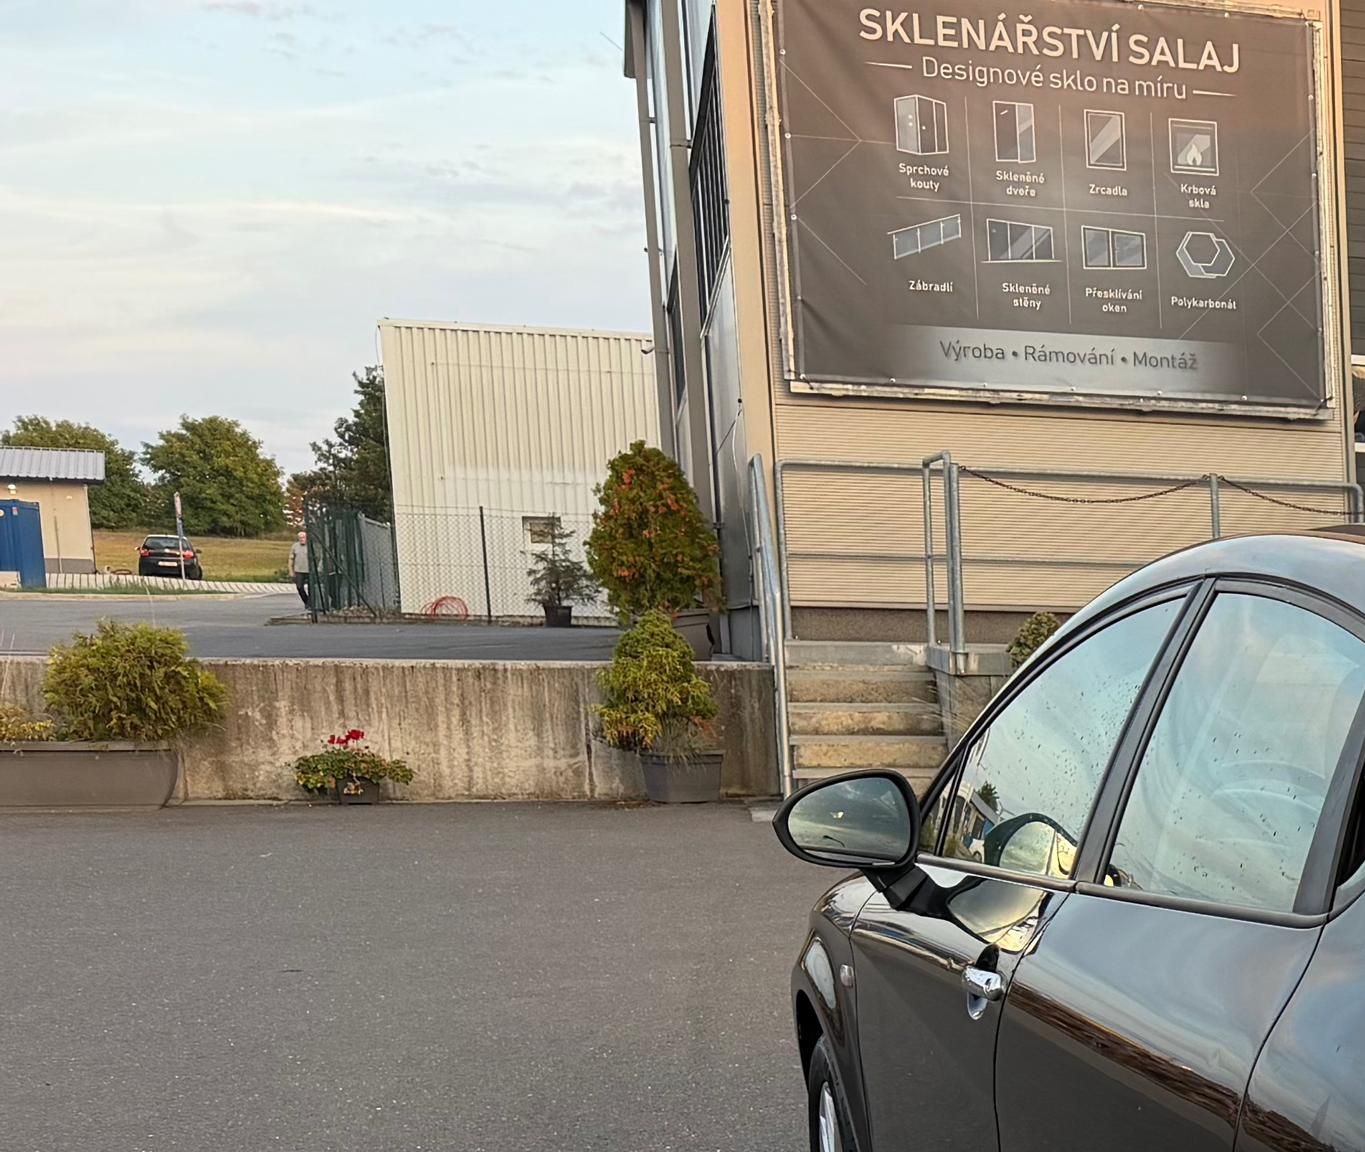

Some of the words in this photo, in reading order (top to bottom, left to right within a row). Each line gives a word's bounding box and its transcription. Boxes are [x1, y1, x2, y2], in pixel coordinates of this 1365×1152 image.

[858, 8, 1120, 62] SKLENÁŘSTVÍ
[1128, 34, 1240, 73] SALAJ
[922, 56, 1043, 87] Designové
[1049, 68, 1097, 92] sklo
[1103, 77, 1129, 95] na
[1135, 77, 1186, 99] míru
[899, 163, 949, 176] Sprchové
[996, 170, 1045, 184] Skleněné
[910, 178, 940, 192] kouty
[1006, 185, 1036, 197] dveře
[1089, 183, 1128, 196] Zrcadla
[1180, 183, 1217, 195] Krbová
[1188, 198, 1210, 208] skla
[908, 280, 953, 292] Zábradlí
[1002, 282, 1051, 295] Skleněné
[1013, 297, 1041, 310] stěny
[1102, 302, 1127, 313] oken
[1171, 296, 1237, 310] Polykarbonát
[939, 340, 1005, 361] Výroba
[1024, 344, 1115, 366] Rámování
[1133, 351, 1198, 370] Montáž
